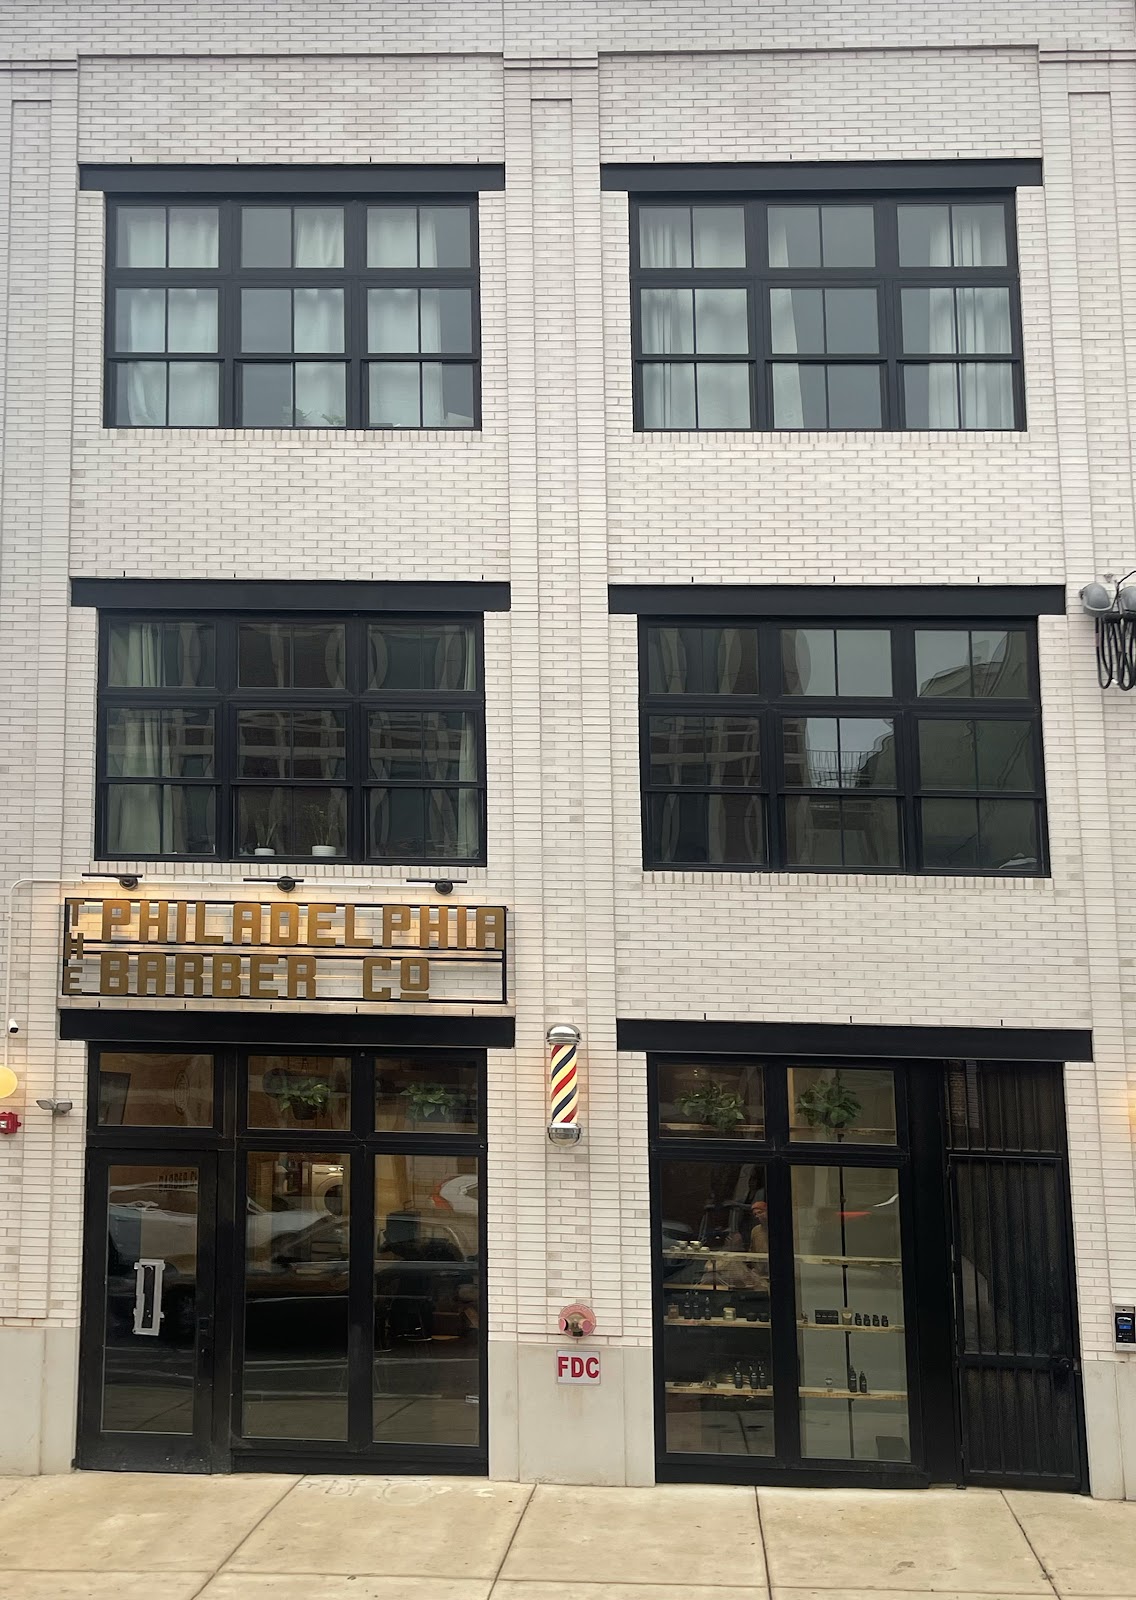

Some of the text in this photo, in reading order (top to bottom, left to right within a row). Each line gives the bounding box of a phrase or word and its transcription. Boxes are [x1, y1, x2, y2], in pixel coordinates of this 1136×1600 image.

[63, 899, 85, 995] THE
[101, 899, 504, 949] PHILADELPHIA
[100, 952, 429, 1000] BARBER CO
[558, 1356, 599, 1378] FDC
